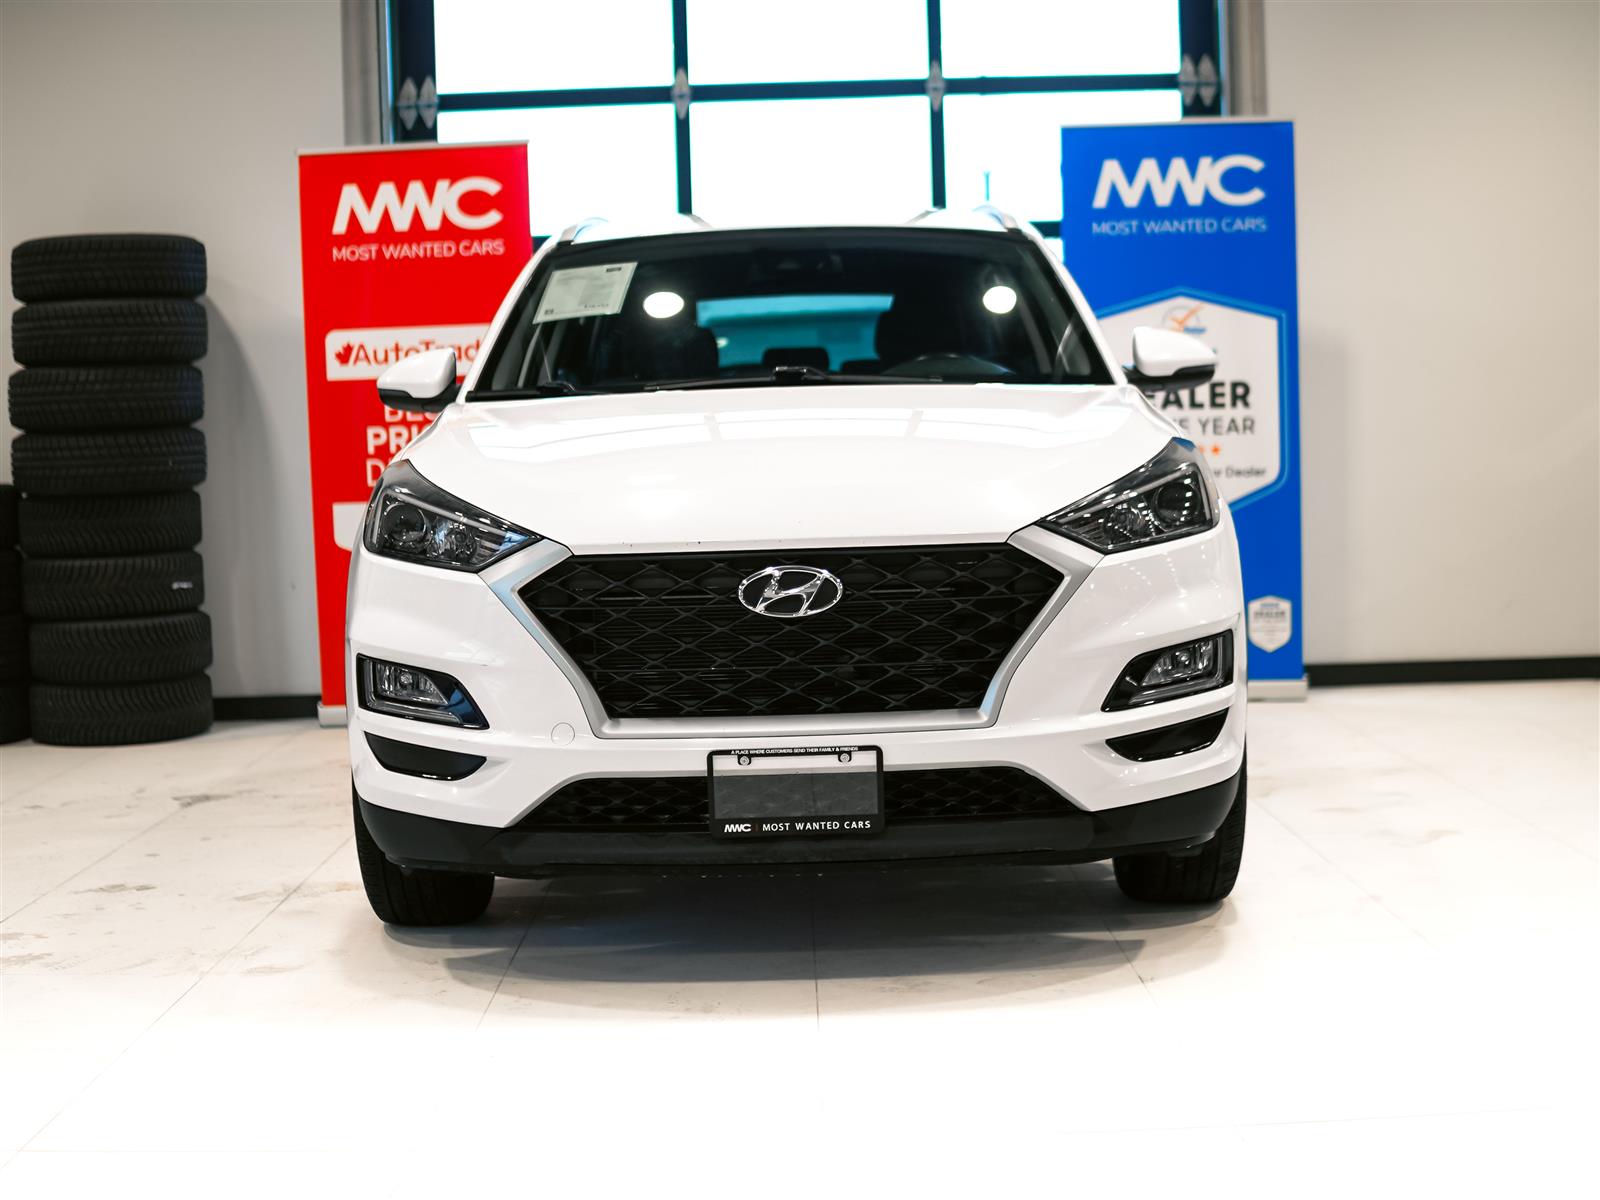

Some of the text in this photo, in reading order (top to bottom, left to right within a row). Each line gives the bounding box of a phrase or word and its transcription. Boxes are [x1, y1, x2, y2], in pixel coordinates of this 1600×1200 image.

[1092, 154, 1266, 209] MWC
[331, 176, 503, 235] MWC
[1091, 216, 1267, 236] MOST WANTED CARS
[332, 238, 505, 262] MOST WANTED CARS
[1198, 418, 1255, 436] YEAR
[724, 820, 871, 833] MWC MOST WANTED CARS
